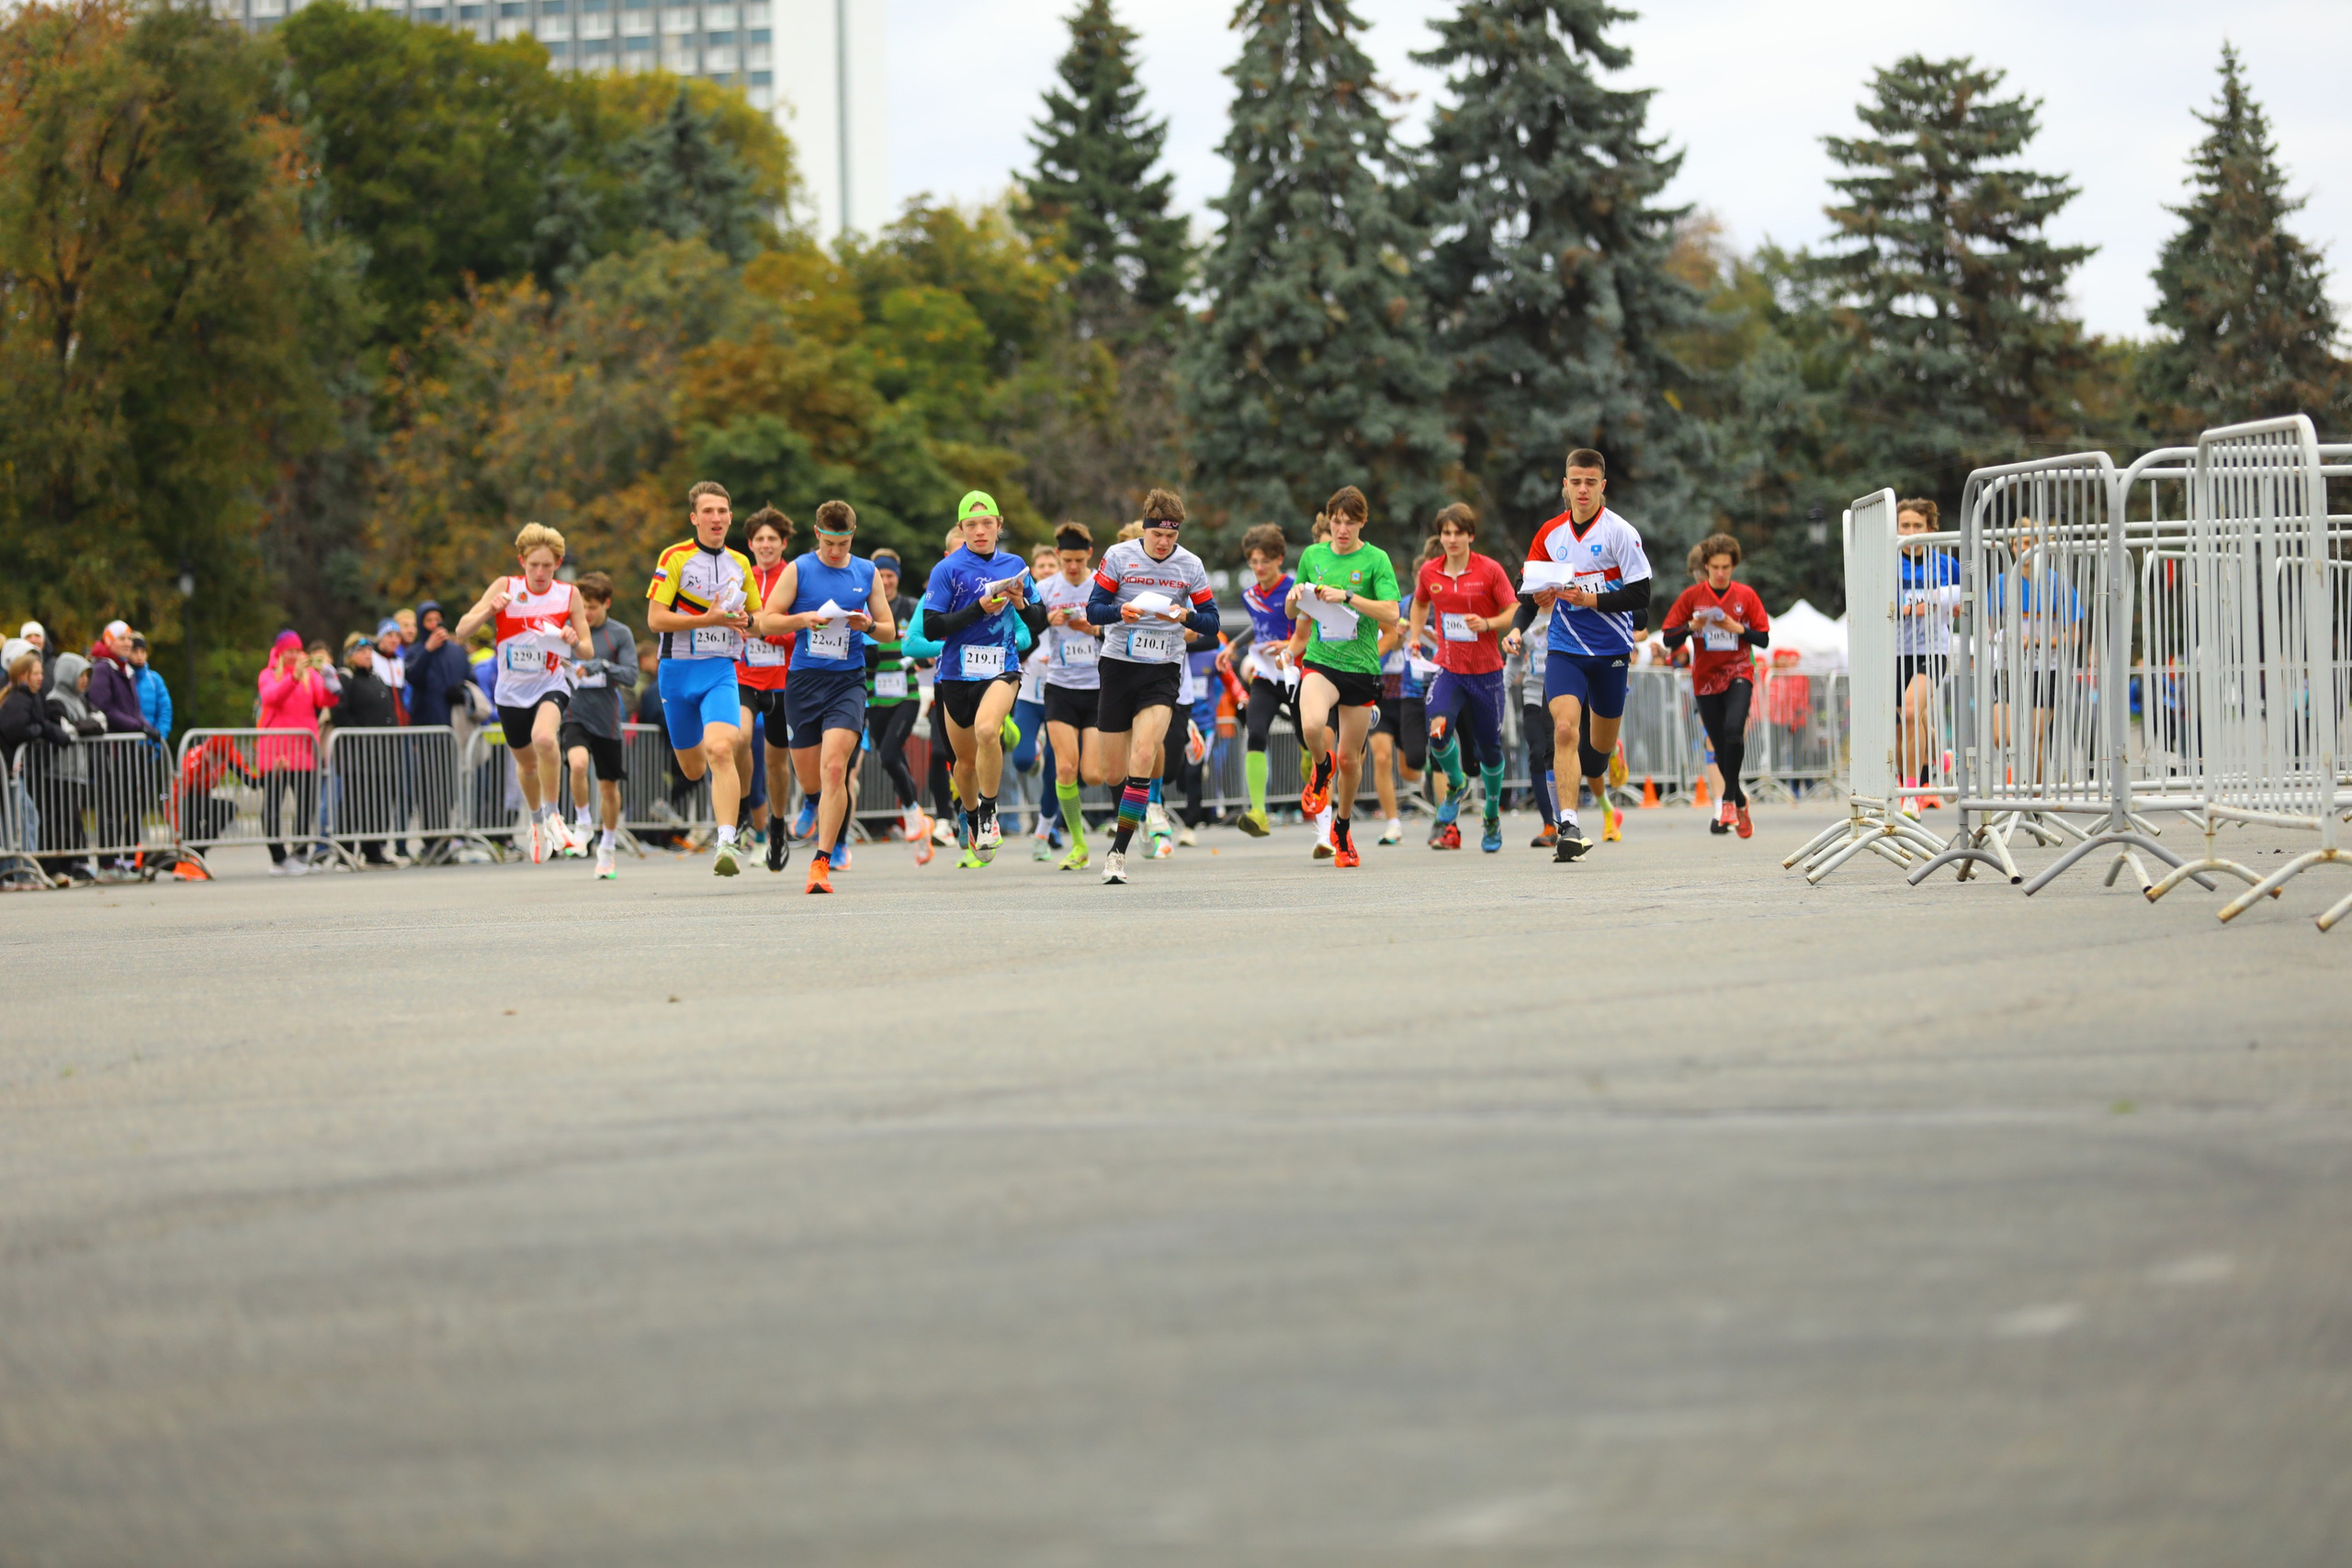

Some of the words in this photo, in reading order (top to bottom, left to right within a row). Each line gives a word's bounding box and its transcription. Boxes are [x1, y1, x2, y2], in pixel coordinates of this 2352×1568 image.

[1122, 576, 1155, 585] NORD
[1159, 579, 1191, 589] WEST
[696, 632, 727, 642] 236.1
[749, 644, 776, 654] 232.1
[1136, 637, 1166, 650] 210.1
[514, 651, 541, 661] 229.1
[1066, 645, 1091, 656] 216.1
[967, 652, 997, 664] 219.1
